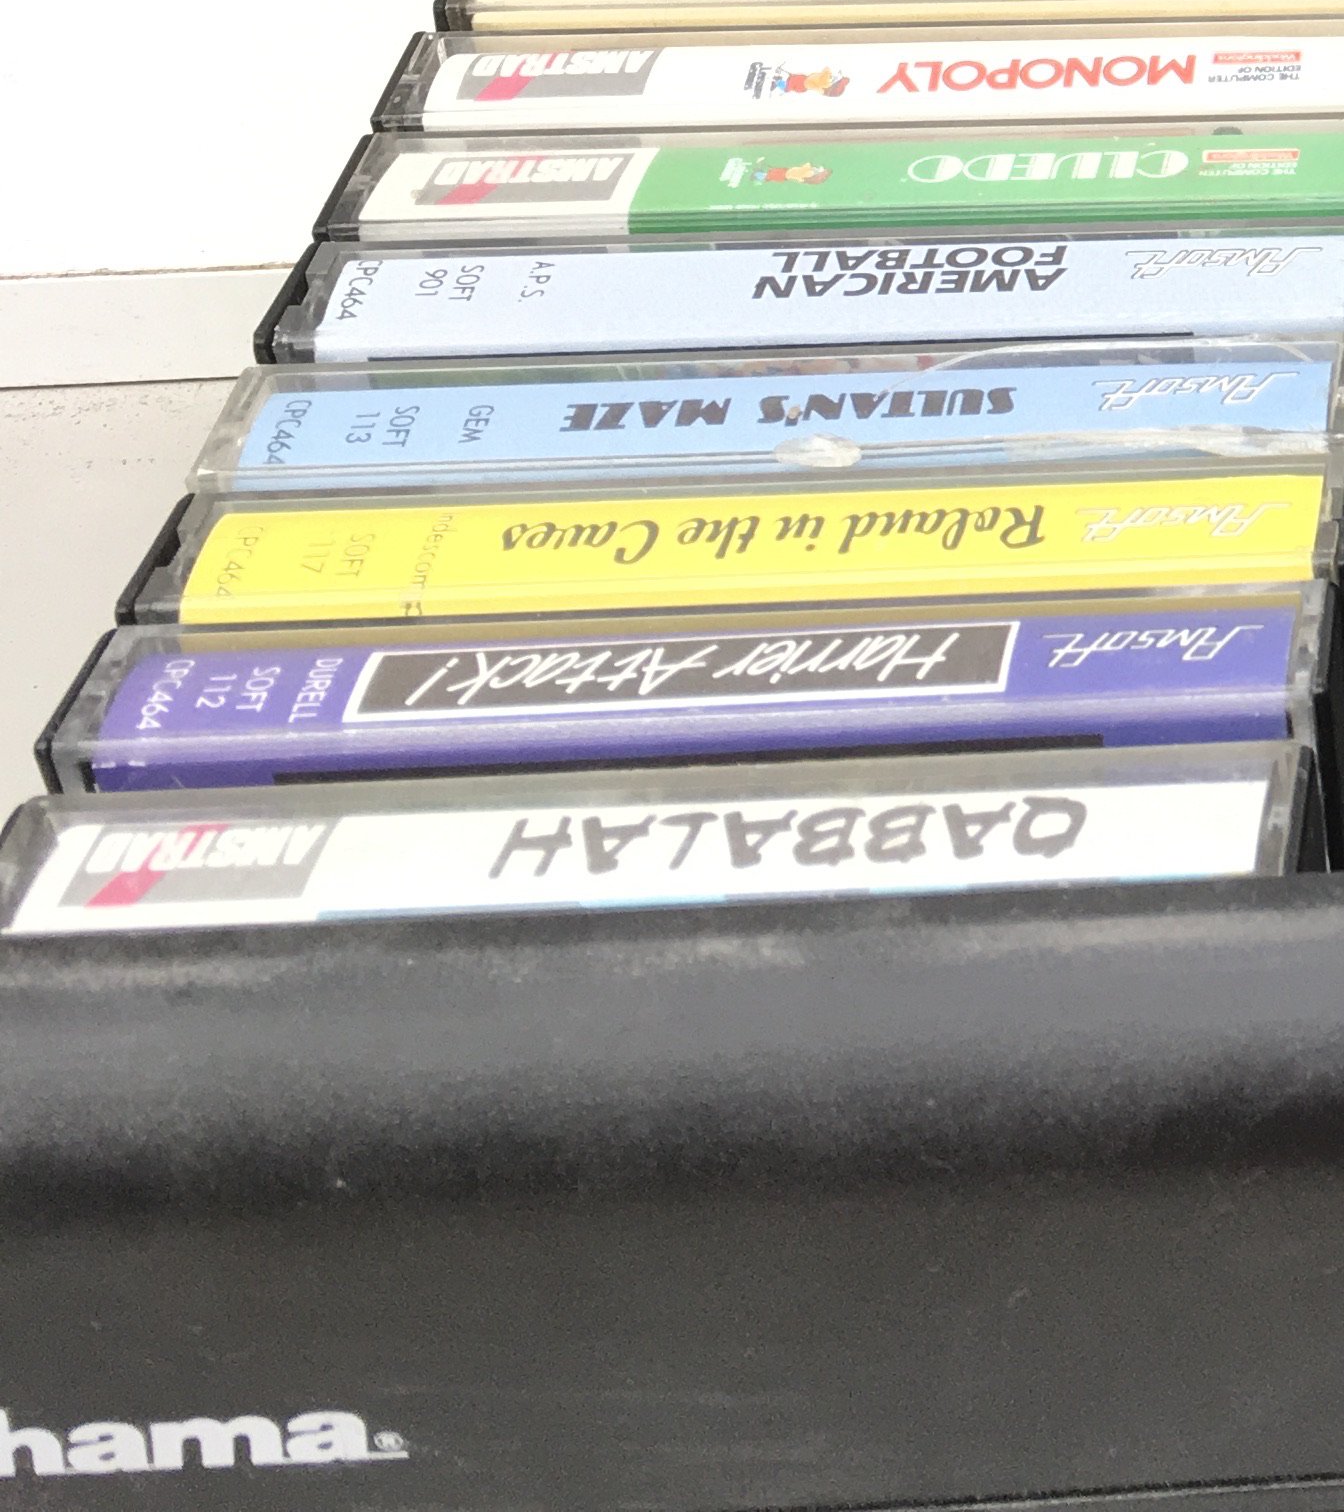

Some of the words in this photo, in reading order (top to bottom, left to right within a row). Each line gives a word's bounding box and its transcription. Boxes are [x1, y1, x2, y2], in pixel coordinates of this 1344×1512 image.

[475, 50, 652, 78] AMSTRAD
[878, 54, 1197, 93] MONOPOLY
[435, 155, 619, 188] AMSTRAD
[907, 149, 1190, 184] CLUEDO
[770, 247, 1066, 272] FOOTBALL
[1124, 245, 1324, 279] Amsoft
[753, 272, 1066, 299] AMERICAN
[755, 386, 1017, 426] SULTAN'S
[1091, 370, 1299, 413] Amsoft
[560, 397, 732, 431] MAZE
[502, 518, 660, 564] Caves
[677, 516, 760, 560] the
[776, 514, 826, 556] in
[838, 500, 1046, 554] Roland
[1073, 498, 1290, 543] Amsoft
[709, 628, 956, 691] Harrier
[1032, 624, 1263, 668] Amsoft
[405, 644, 710, 706] Attack!
[86, 822, 322, 874] AMSTRAD
[489, 797, 1089, 879] QABBALAH
[0, 1408, 368, 1476] hama
